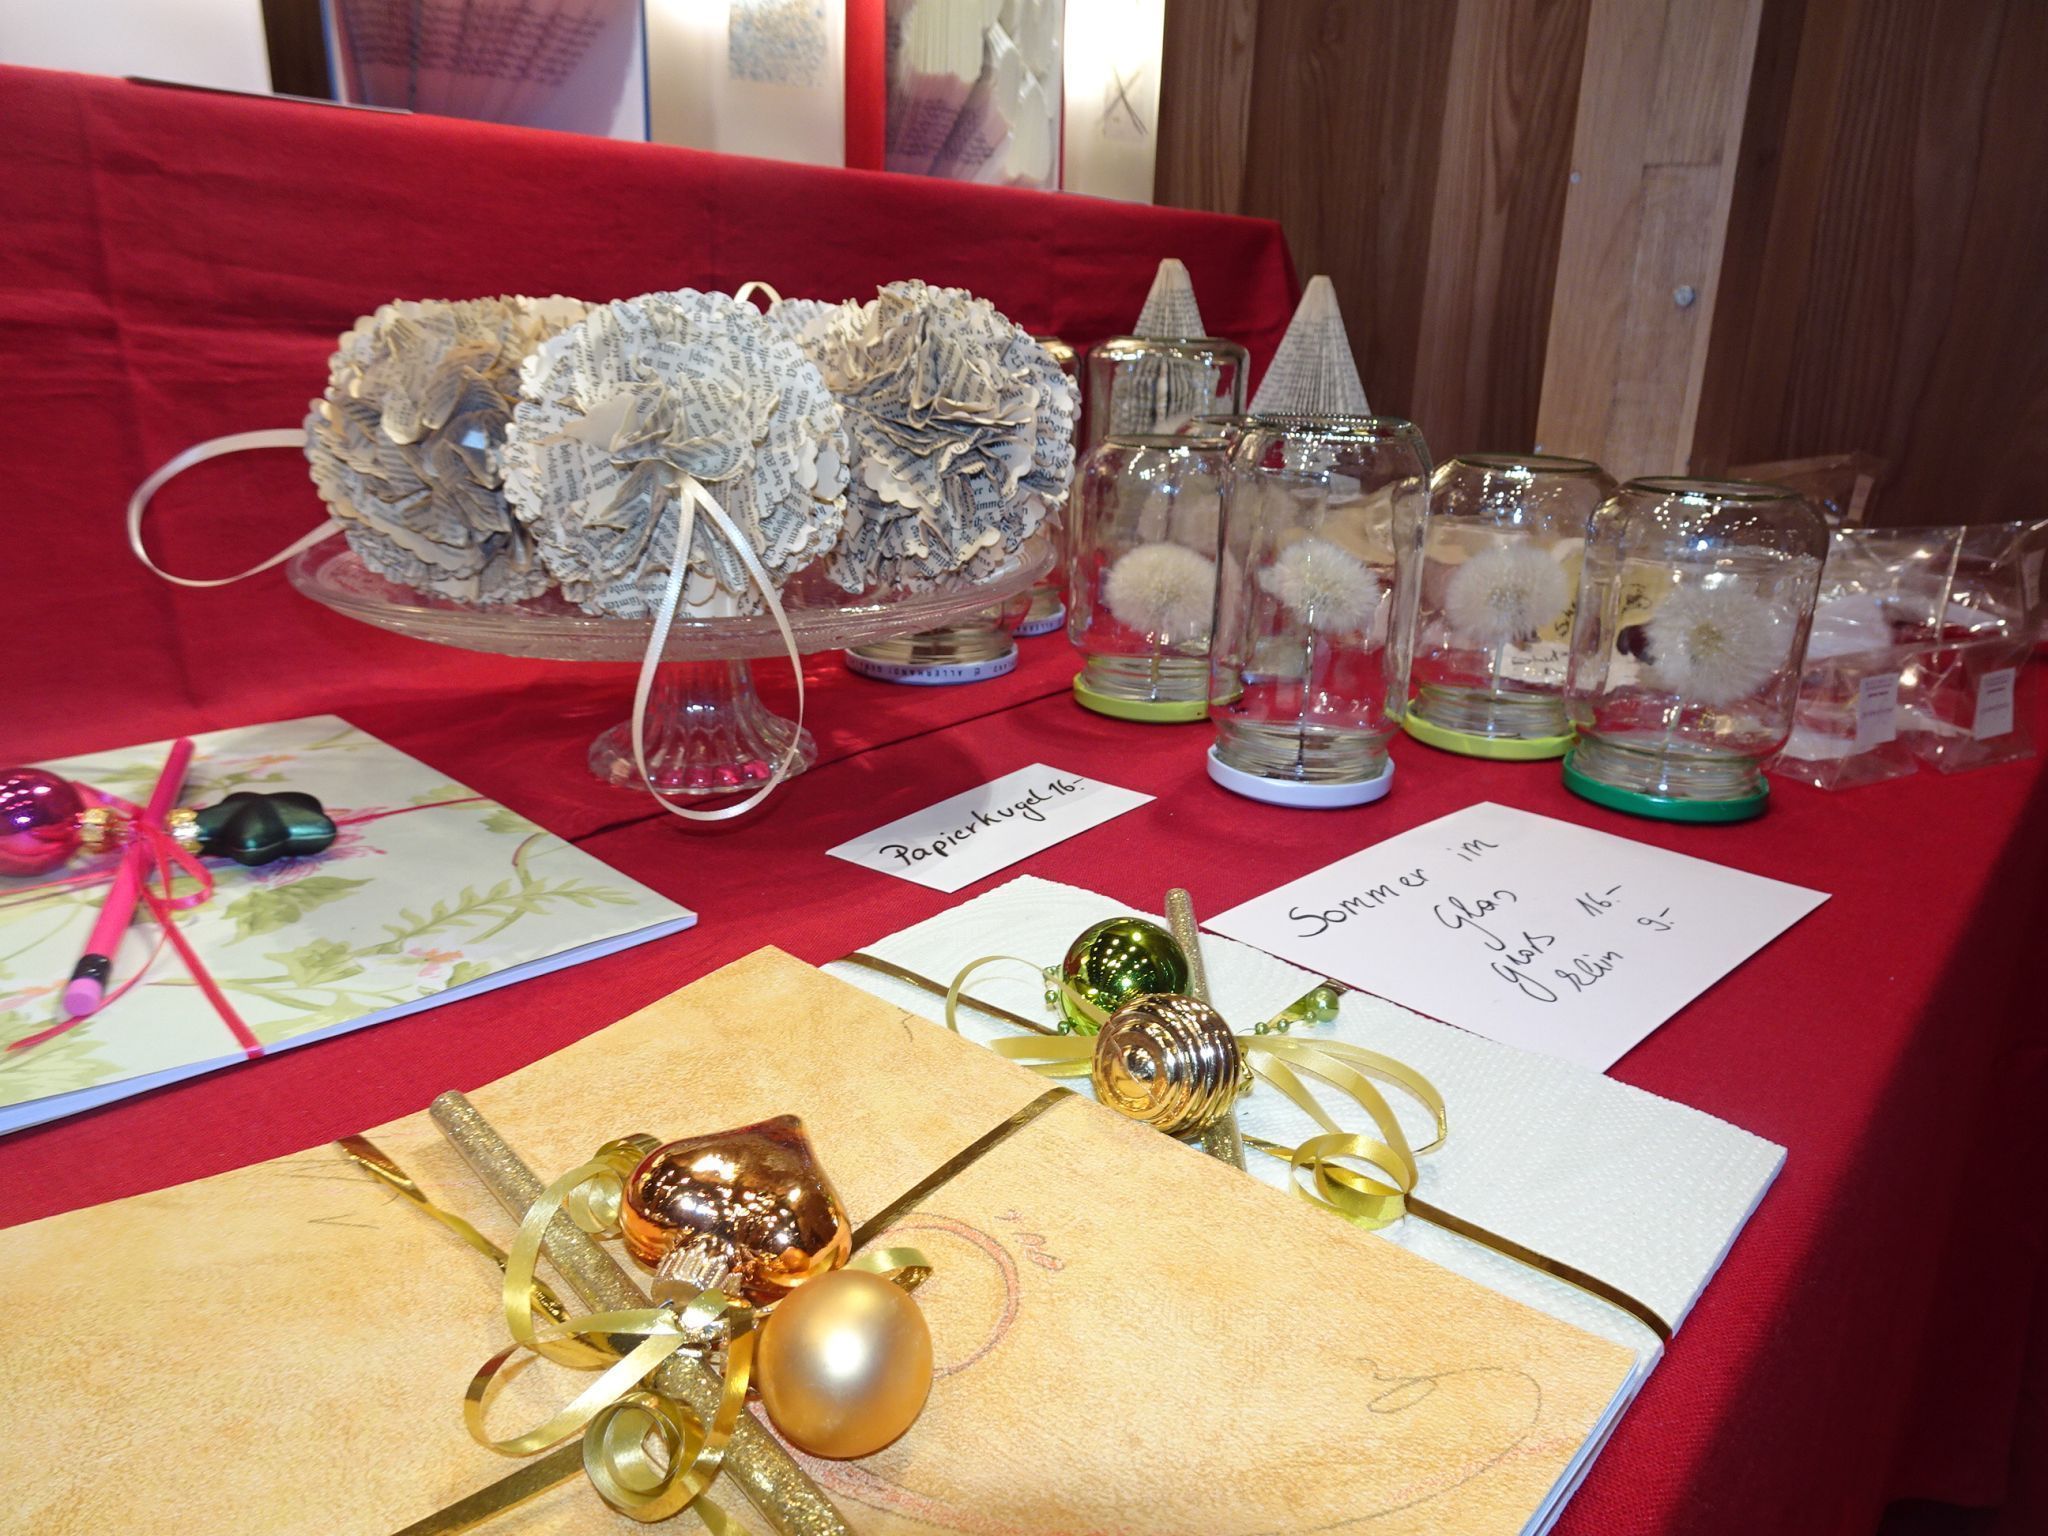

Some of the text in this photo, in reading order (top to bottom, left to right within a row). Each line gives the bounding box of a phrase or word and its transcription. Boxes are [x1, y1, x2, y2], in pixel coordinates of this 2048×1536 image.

[879, 788, 1053, 866] Papierkugel
[1289, 839, 1499, 937] Sommer im
[1434, 890, 1517, 951] Glas
